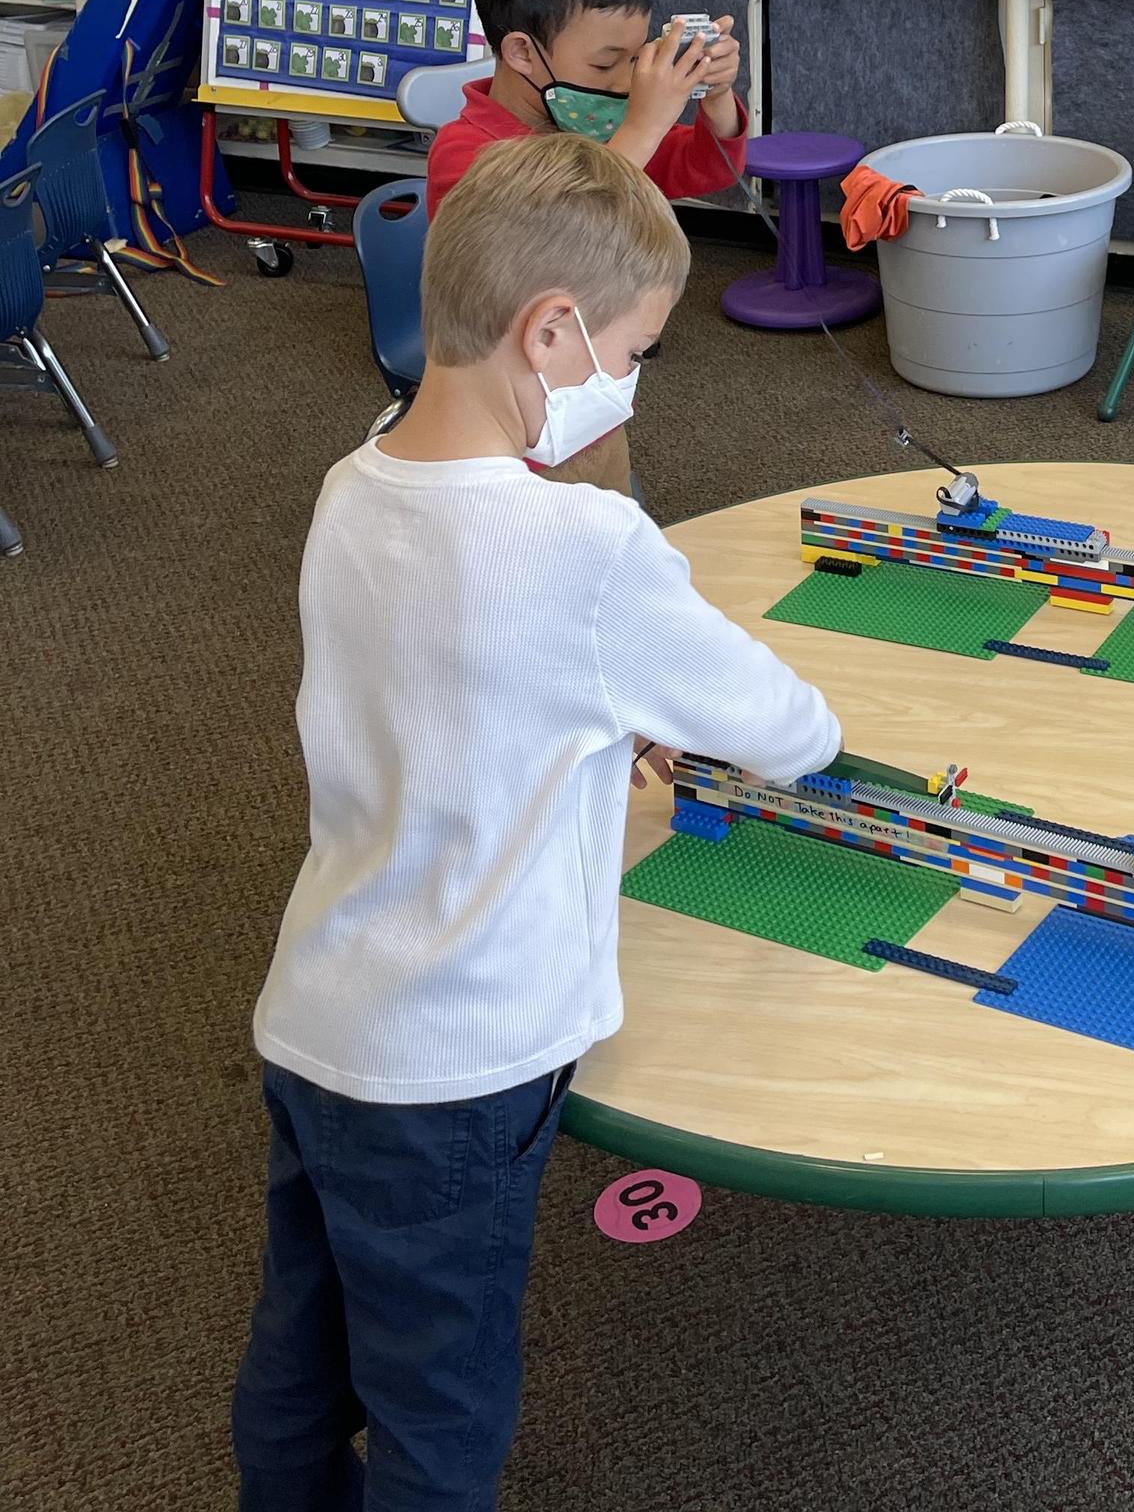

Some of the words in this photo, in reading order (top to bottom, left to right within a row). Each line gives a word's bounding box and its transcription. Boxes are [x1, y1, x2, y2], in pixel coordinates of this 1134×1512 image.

[734, 785, 751, 800] Do
[757, 791, 785, 808] NOT
[618, 1179, 679, 1231] 30
